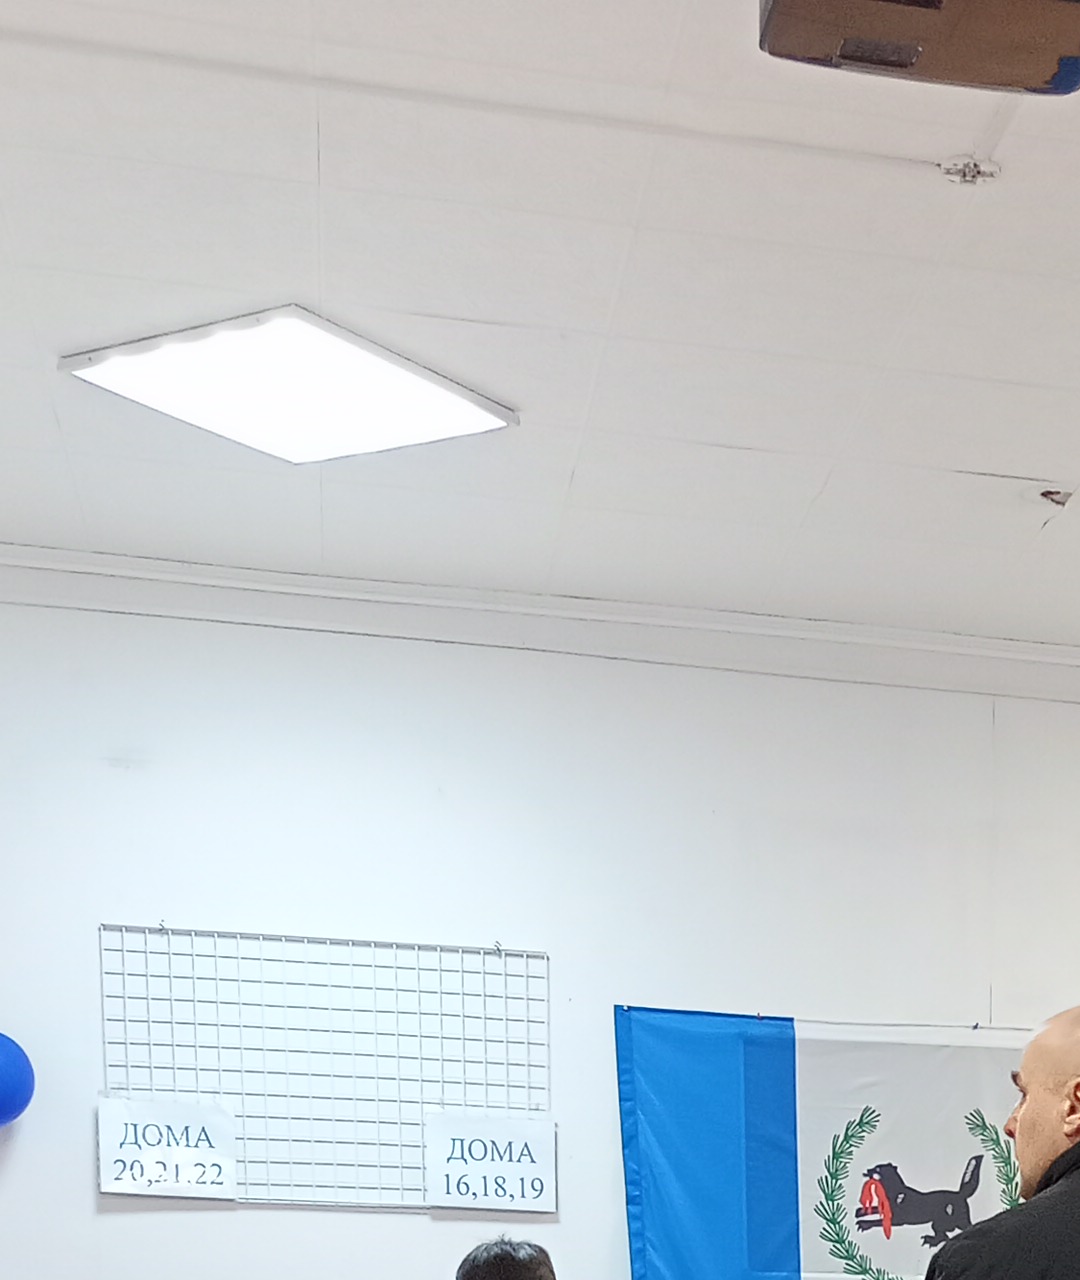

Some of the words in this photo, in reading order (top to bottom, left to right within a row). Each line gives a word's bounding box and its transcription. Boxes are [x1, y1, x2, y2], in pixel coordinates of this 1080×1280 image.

[119, 1122, 216, 1150] ДОМА
[446, 1137, 537, 1165] ДОМА
[444, 1173, 544, 1202] 16,18,19
